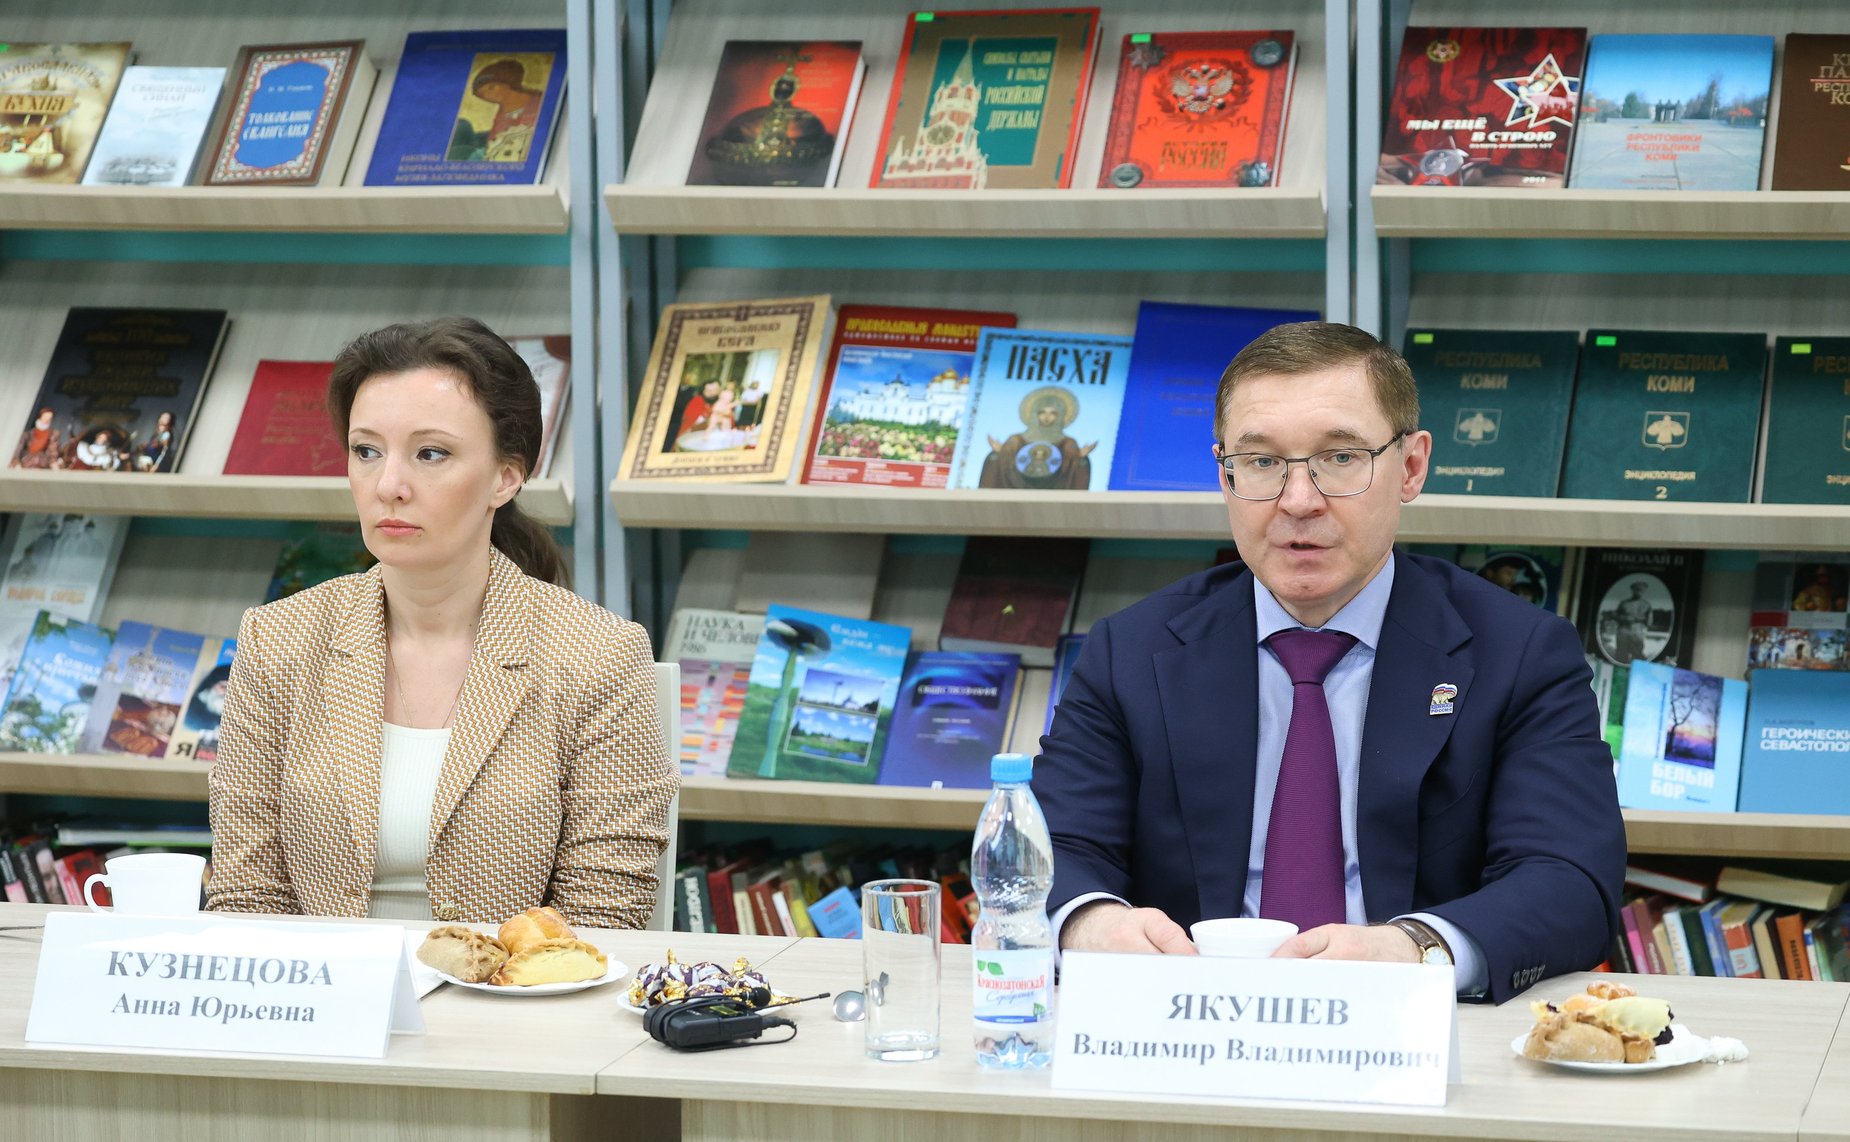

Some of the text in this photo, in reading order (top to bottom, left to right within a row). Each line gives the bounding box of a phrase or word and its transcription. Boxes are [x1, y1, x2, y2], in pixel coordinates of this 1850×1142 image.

[986, 110, 1040, 132] ДЕРЖАВЫ
[1406, 116, 1487, 131] МЫ ЕЩЁ
[1471, 131, 1557, 143] В СТРОЮ
[1626, 133, 1703, 142] ФРОНТОВИКИ
[1625, 143, 1700, 152] РЕСПУБЛИКИ
[1645, 153, 1678, 161] КОМИ
[1005, 344, 1112, 386] ПАСХА
[1434, 352, 1542, 369] РЕСПУБЛИКА
[1619, 353, 1729, 372] РЕСПУБЛИКА
[1813, 356, 1850, 374] РЕС
[1460, 374, 1509, 390] КОМИ
[1647, 375, 1696, 393] КОМИ
[1435, 465, 1505, 477] ЭНЦИКЛОПЕДИЯ
[1624, 469, 1696, 482] ЭНЦИКЛОПЕДИЯ
[1466, 479, 1474, 491] 1
[1655, 486, 1668, 499] 2
[687, 616, 744, 630] НАУКА
[1652, 763, 1715, 788] БЕЛЫЙ
[1650, 780, 1686, 799] БОР
[107, 950, 333, 988] КУЗНЕЦОВА
[110, 992, 316, 1026] Анна Юрьевна
[1167, 992, 1350, 1026] ЯКУШЕВ
[1072, 1032, 1440, 1072] Владимир Владимирович
